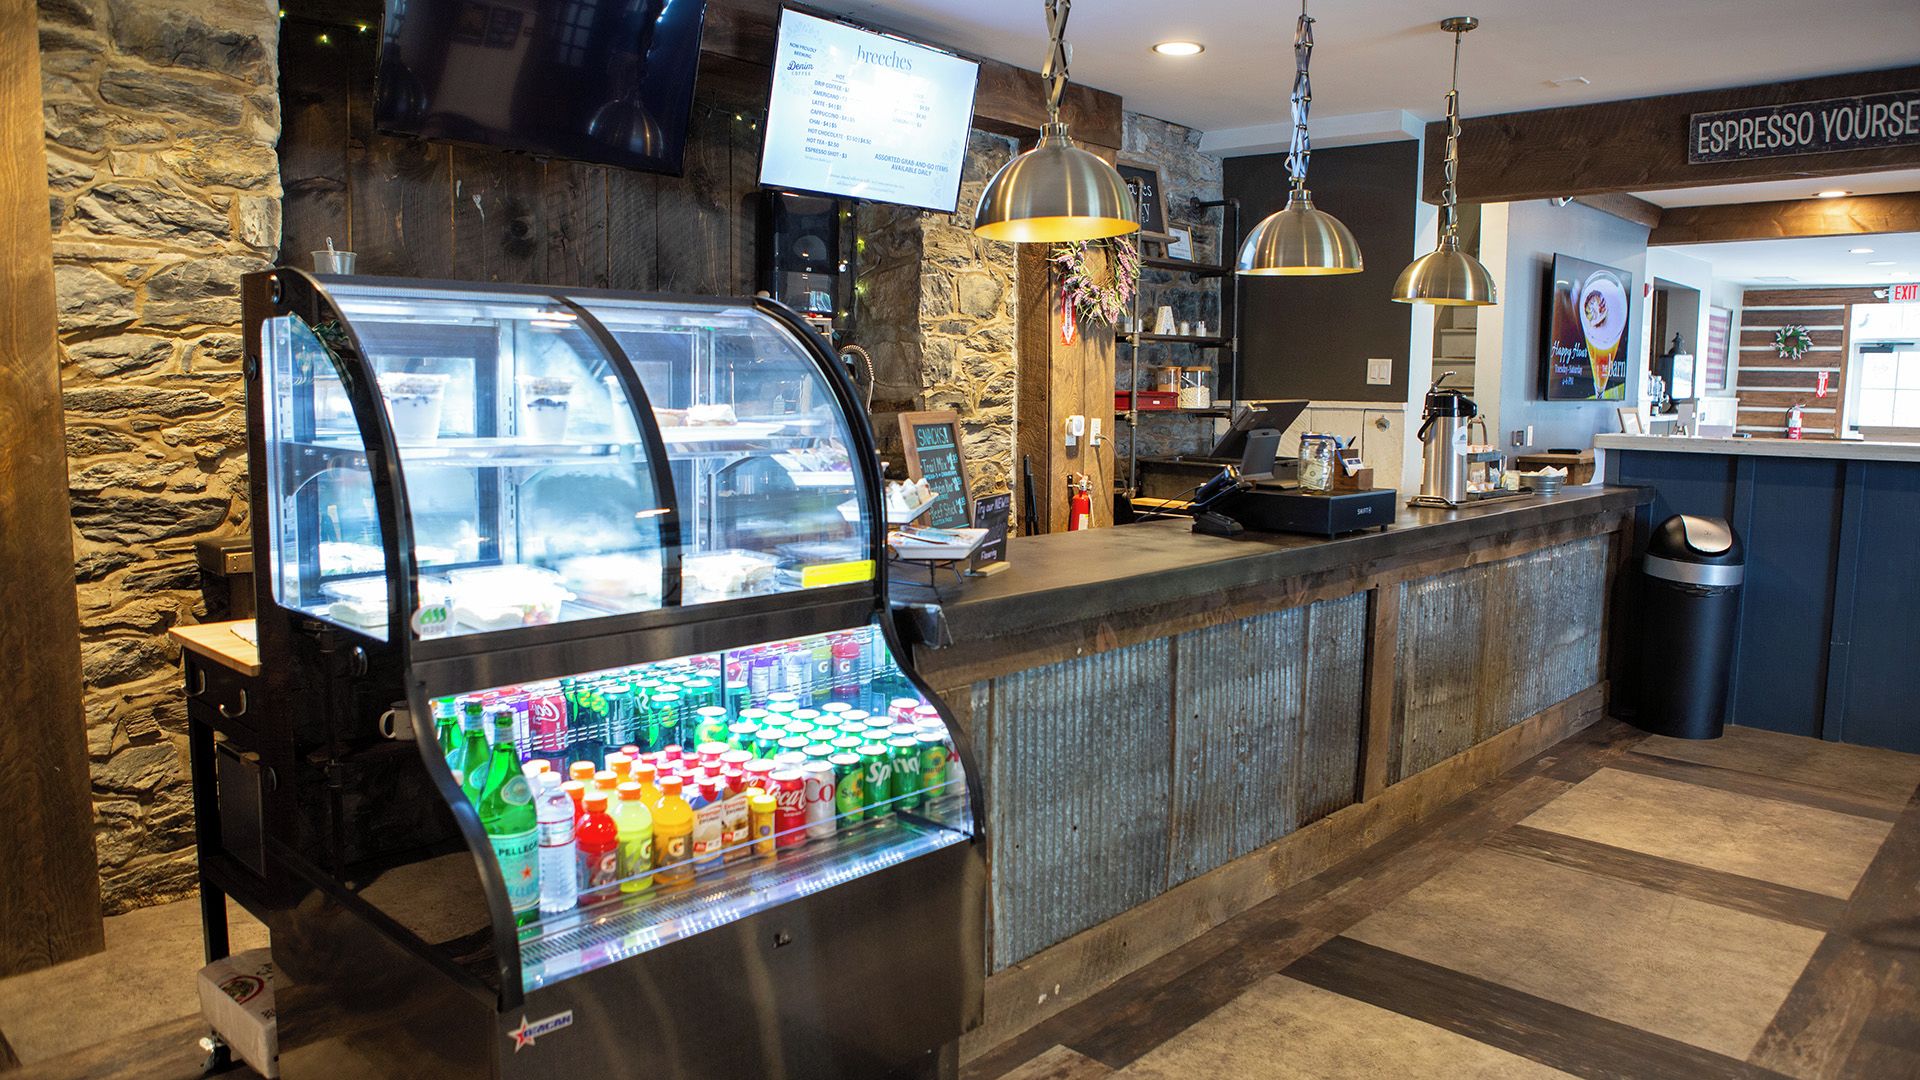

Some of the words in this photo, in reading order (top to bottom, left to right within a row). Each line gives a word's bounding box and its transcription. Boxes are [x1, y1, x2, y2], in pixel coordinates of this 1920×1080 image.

[787, 60, 814, 70] Denim
[857, 45, 912, 71] breeches
[1697, 111, 1814, 154] ESPRESSO
[1821, 100, 1920, 143] YOURSE
[875, 153, 901, 163] ASSORTED
[891, 164, 917, 174] AVAILABLE
[1894, 284, 1919, 300] EXIT
[1551, 340, 1572, 364] Happy
[1572, 342, 1588, 360] Hour
[917, 426, 949, 447] SNACKS!
[921, 458, 936, 474] Trail
[977, 501, 986, 520] Try
